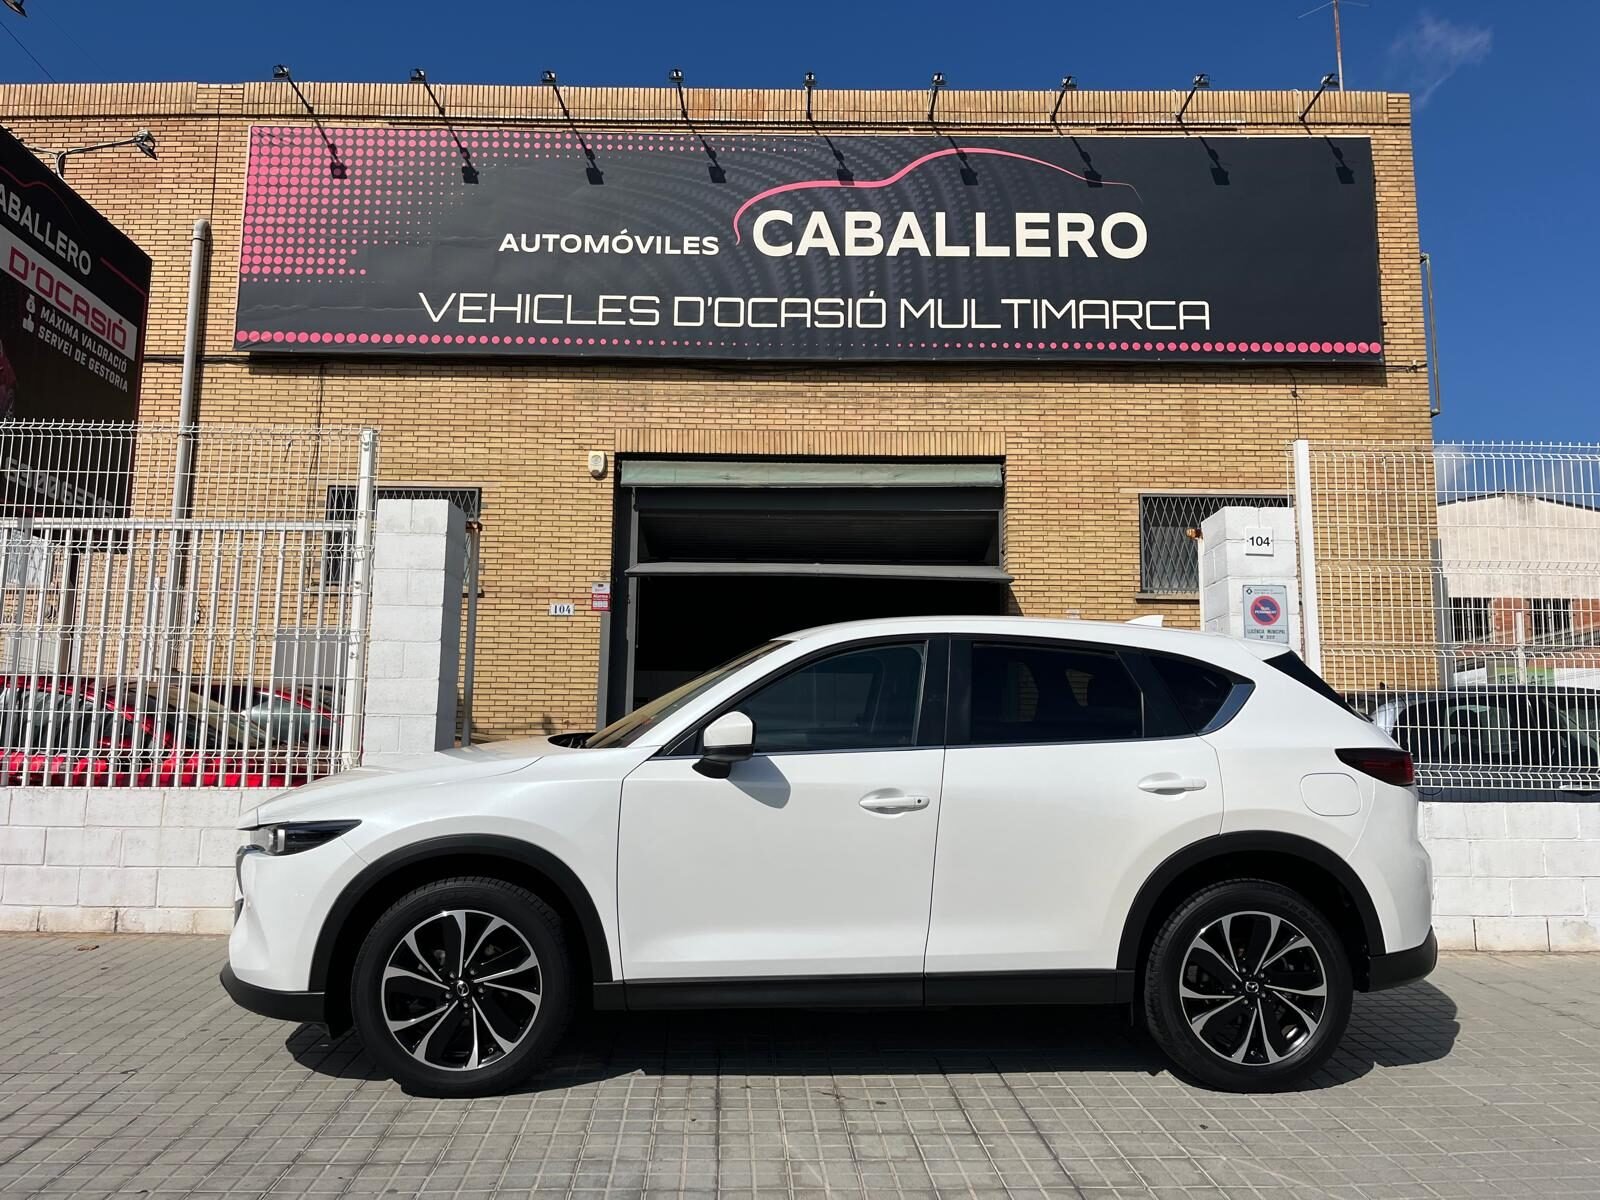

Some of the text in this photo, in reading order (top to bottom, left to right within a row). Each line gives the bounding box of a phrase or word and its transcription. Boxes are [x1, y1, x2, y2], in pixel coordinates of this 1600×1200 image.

[498, 209, 1148, 259] AUTOMÓVILES CABALLERO
[9, 246, 127, 351] D'OCASIÓ
[418, 290, 1210, 331] VEHICLES D'OCASIÓ MULTIMARCA
[38, 325, 128, 393] SERVEI DE GESTORIA
[40, 306, 127, 373] MÀXIMA VALORACIÓ
[1249, 535, 1271, 547] 104
[554, 604, 571, 614] 104
